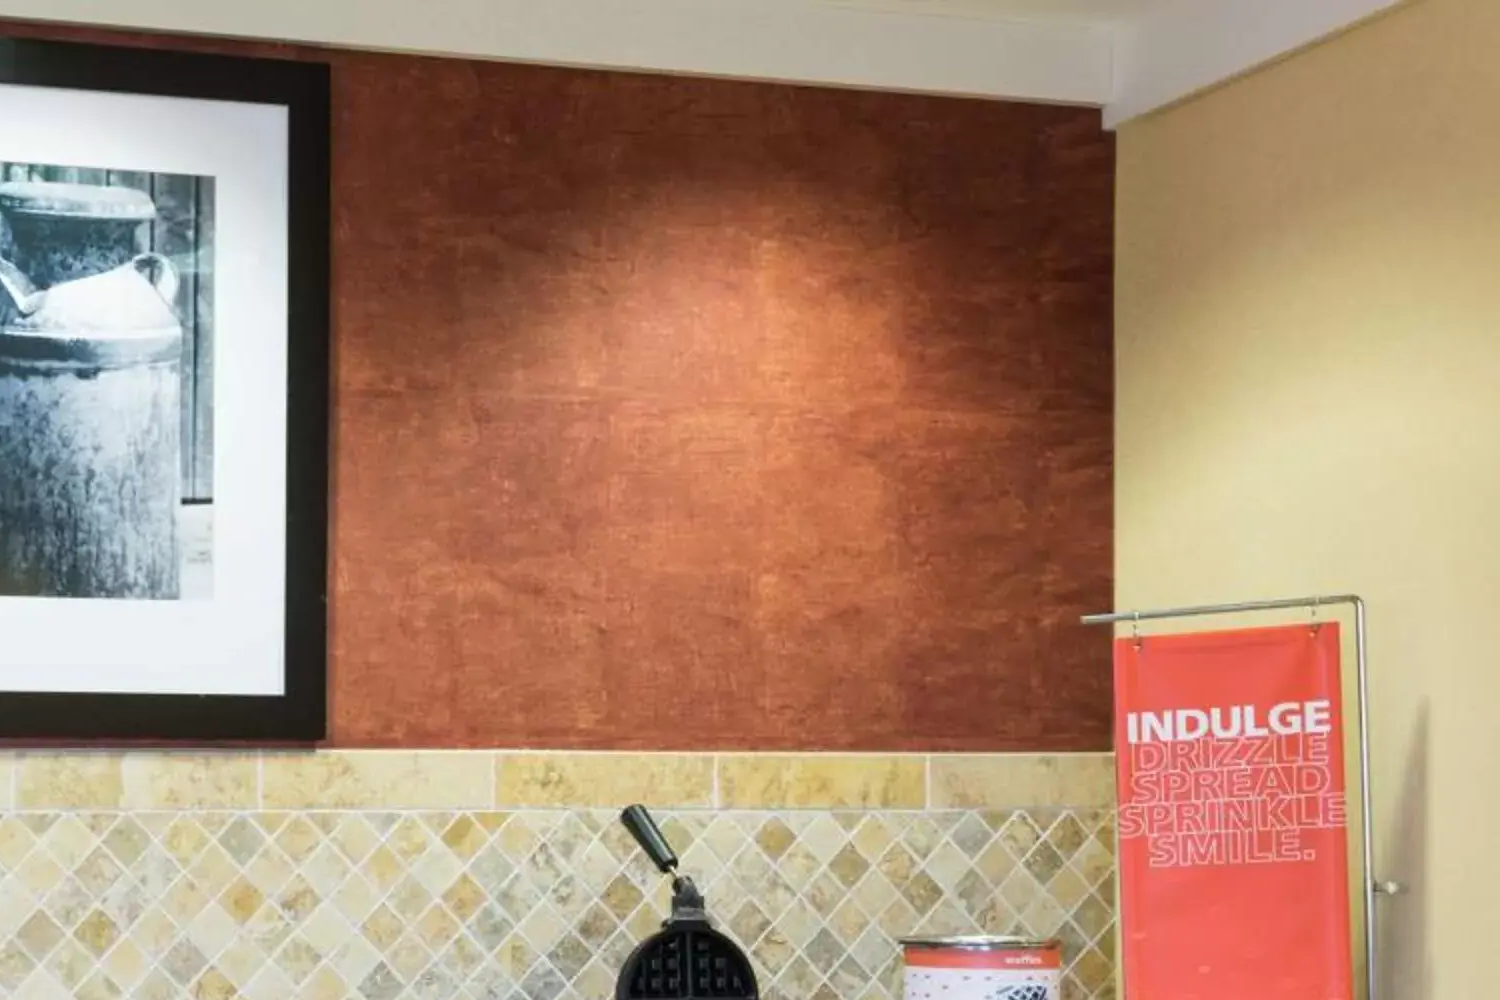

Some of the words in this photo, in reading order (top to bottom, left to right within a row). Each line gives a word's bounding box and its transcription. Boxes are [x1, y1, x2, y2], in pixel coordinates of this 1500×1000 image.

[1126, 700, 1332, 744] INDULGE
[1131, 732, 1329, 774] DRIZZLE
[1131, 763, 1331, 805] SPREAD
[1118, 792, 1348, 839] SPRINKLE
[1149, 827, 1316, 867] SMILE.
